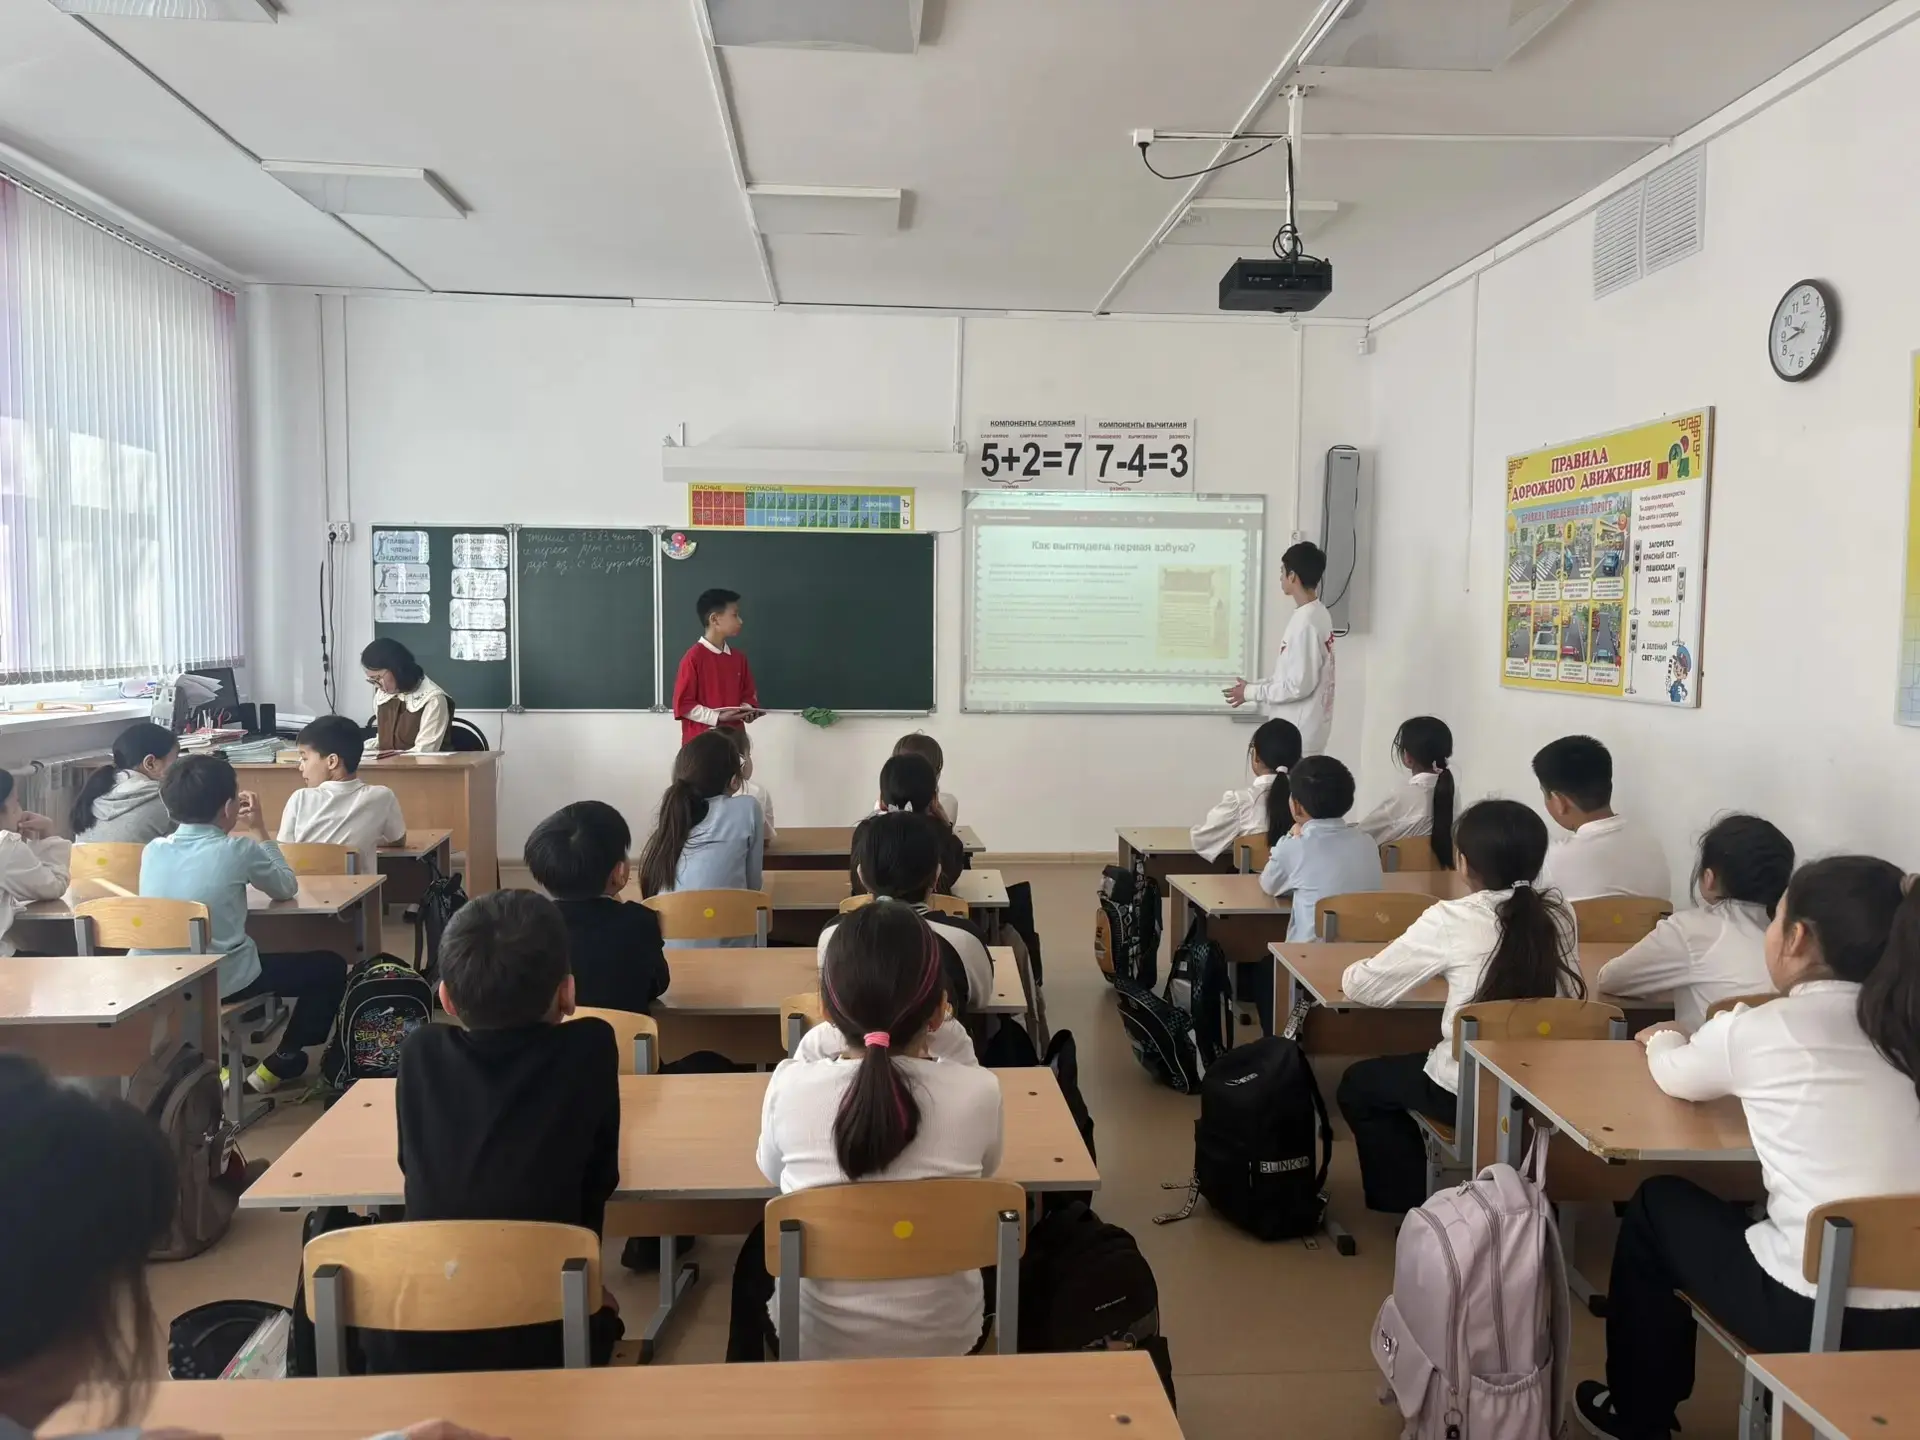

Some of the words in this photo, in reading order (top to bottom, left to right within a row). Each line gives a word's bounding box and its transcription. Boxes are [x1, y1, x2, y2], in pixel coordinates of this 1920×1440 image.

[1803, 293, 1811, 305] 12
[1816, 296, 1819, 306] 1
[1792, 302, 1798, 313] 11
[1784, 315, 1792, 327] 10
[1781, 331, 1786, 343] 9
[1782, 345, 1787, 356] 8
[1810, 349, 1816, 360] 5
[1789, 354, 1795, 366] 7
[1798, 357, 1804, 368] 6
[981, 442, 1082, 477] 5+2=7
[1096, 444, 1188, 478] 7-4=3
[1551, 448, 1608, 473] ПРАВИЛА
[1512, 476, 1575, 501] ДОРОЖНОГО
[1580, 460, 1651, 490] ДВИЖЕНИЯ
[902, 499, 909, 508] Ъ
[1032, 541, 1051, 550] Как
[1114, 543, 1151, 553] первая
[1649, 540, 1674, 548] ЗАГОРЕЛСЯ
[1643, 551, 1665, 560] КРАСНЫЙ
[1646, 564, 1676, 572] ПЕШЕХОДАМ
[1261, 1156, 1304, 1172] BLINKY
